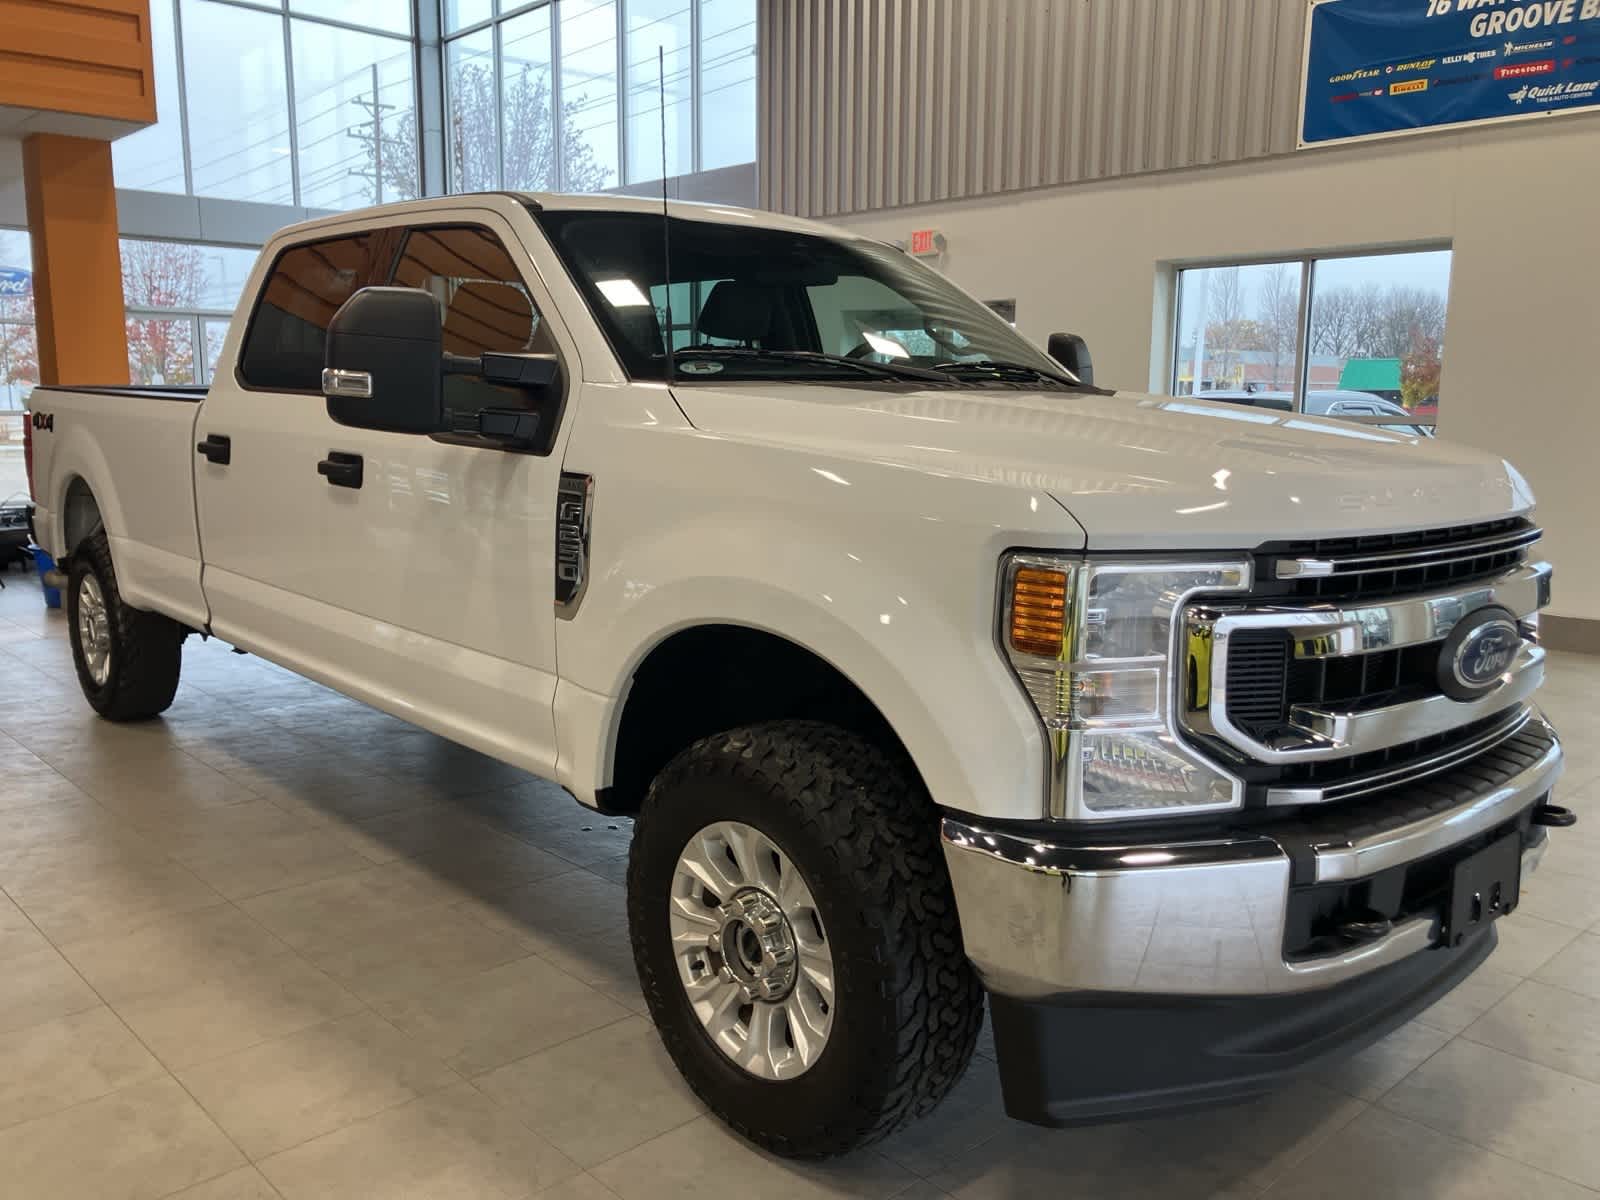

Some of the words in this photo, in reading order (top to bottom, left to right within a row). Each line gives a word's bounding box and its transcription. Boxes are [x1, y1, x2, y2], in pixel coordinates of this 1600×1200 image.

[1470, 0, 1573, 38] GROOVE
[1578, 0, 1600, 20] B
[1513, 41, 1553, 52] MICHELIN
[1396, 59, 1436, 71] DUNLOP
[1500, 64, 1549, 77] Firestone
[1329, 69, 1380, 83] GOODYEAR
[1393, 81, 1425, 93] PIRELLI
[1527, 84, 1565, 99] Quick
[1565, 81, 1599, 93] Lane
[911, 230, 934, 253] EXIT
[1473, 635, 1515, 675] Ford
